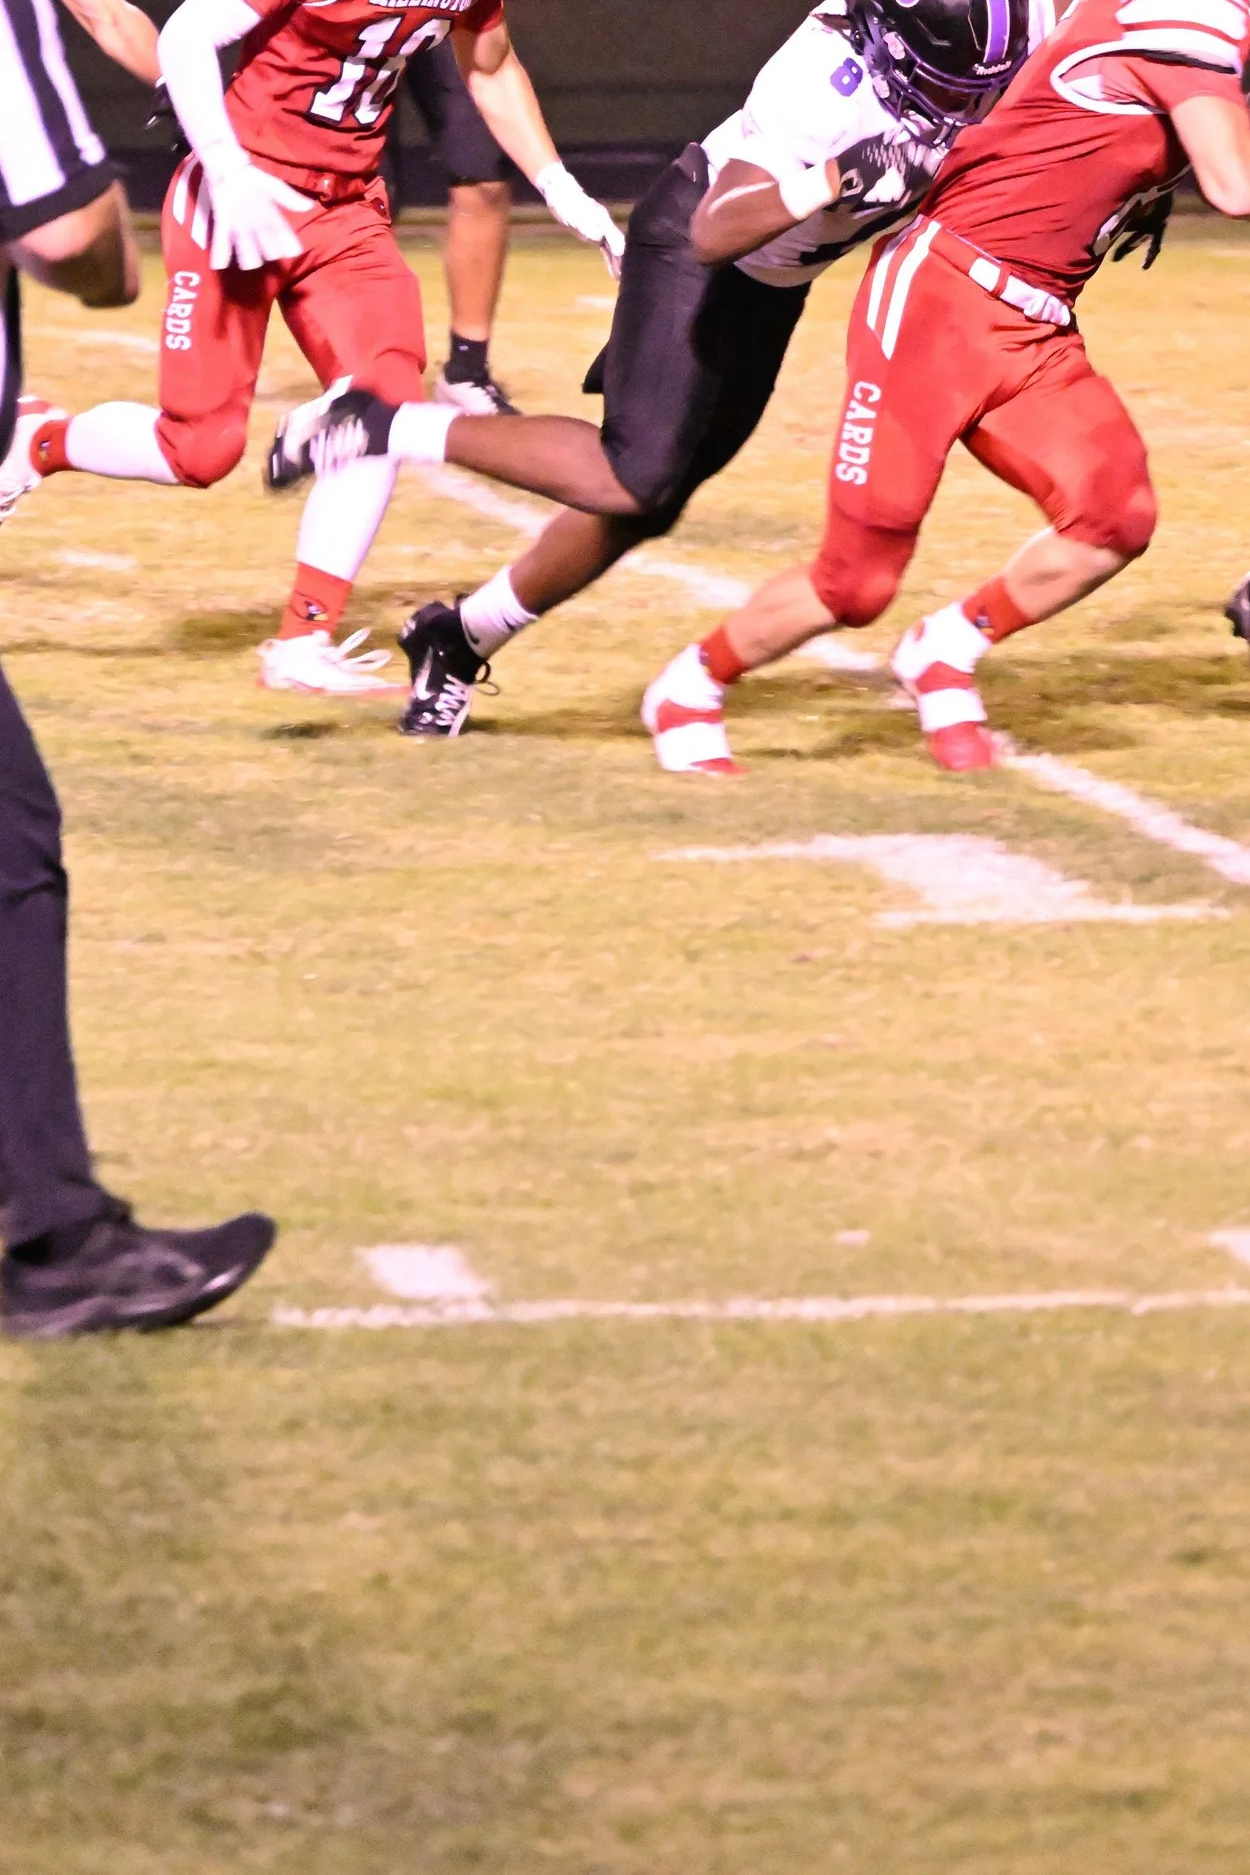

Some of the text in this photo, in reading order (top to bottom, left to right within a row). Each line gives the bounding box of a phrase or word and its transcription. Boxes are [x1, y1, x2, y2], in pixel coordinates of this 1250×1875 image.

[829, 56, 864, 98] 8
[165, 270, 201, 351] CARDS
[834, 380, 882, 486] CARDS
